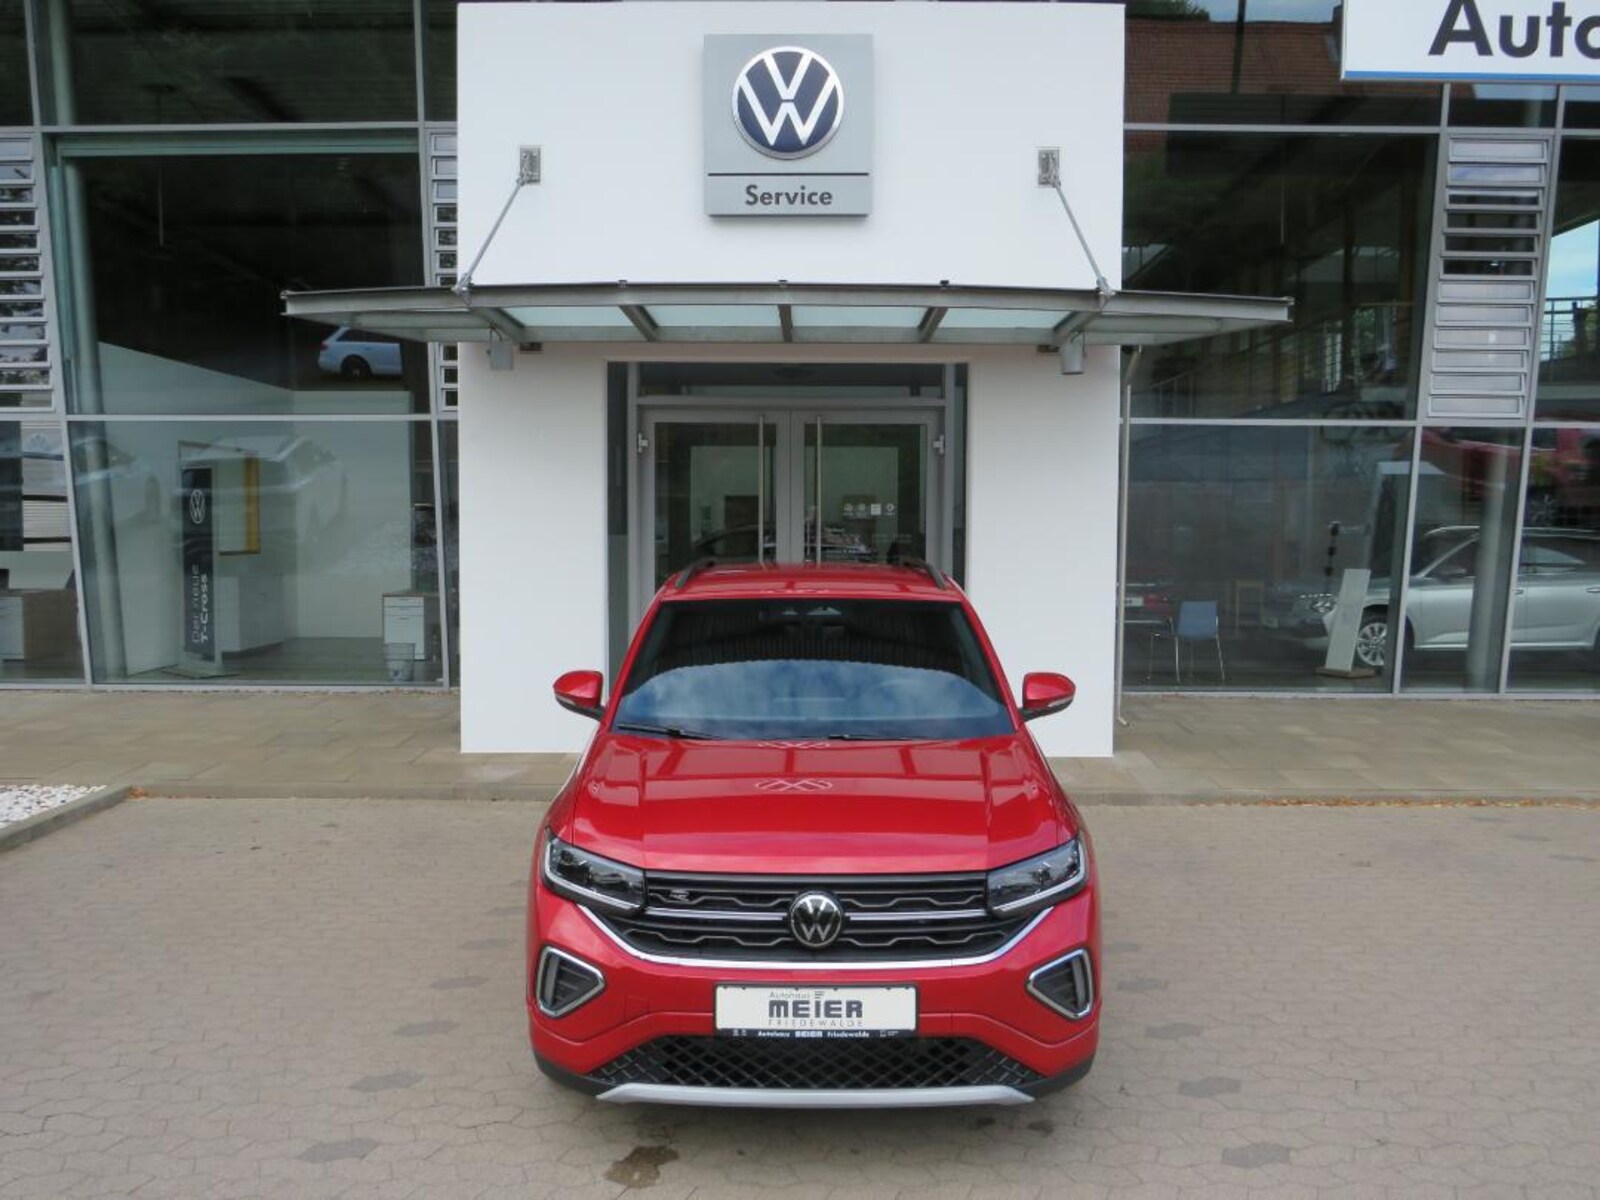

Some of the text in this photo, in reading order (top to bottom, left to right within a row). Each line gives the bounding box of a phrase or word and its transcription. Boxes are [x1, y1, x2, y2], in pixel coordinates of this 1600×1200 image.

[733, 47, 843, 159] VW
[745, 184, 833, 206] Service
[200, 573, 209, 644] T-Cross
[792, 895, 841, 946] VW
[769, 991, 811, 999] Autohaus
[768, 1000, 863, 1018] MEIER
[768, 1018, 863, 1027] FRIEDEWALDE
[758, 1030, 791, 1038] Autohaus
